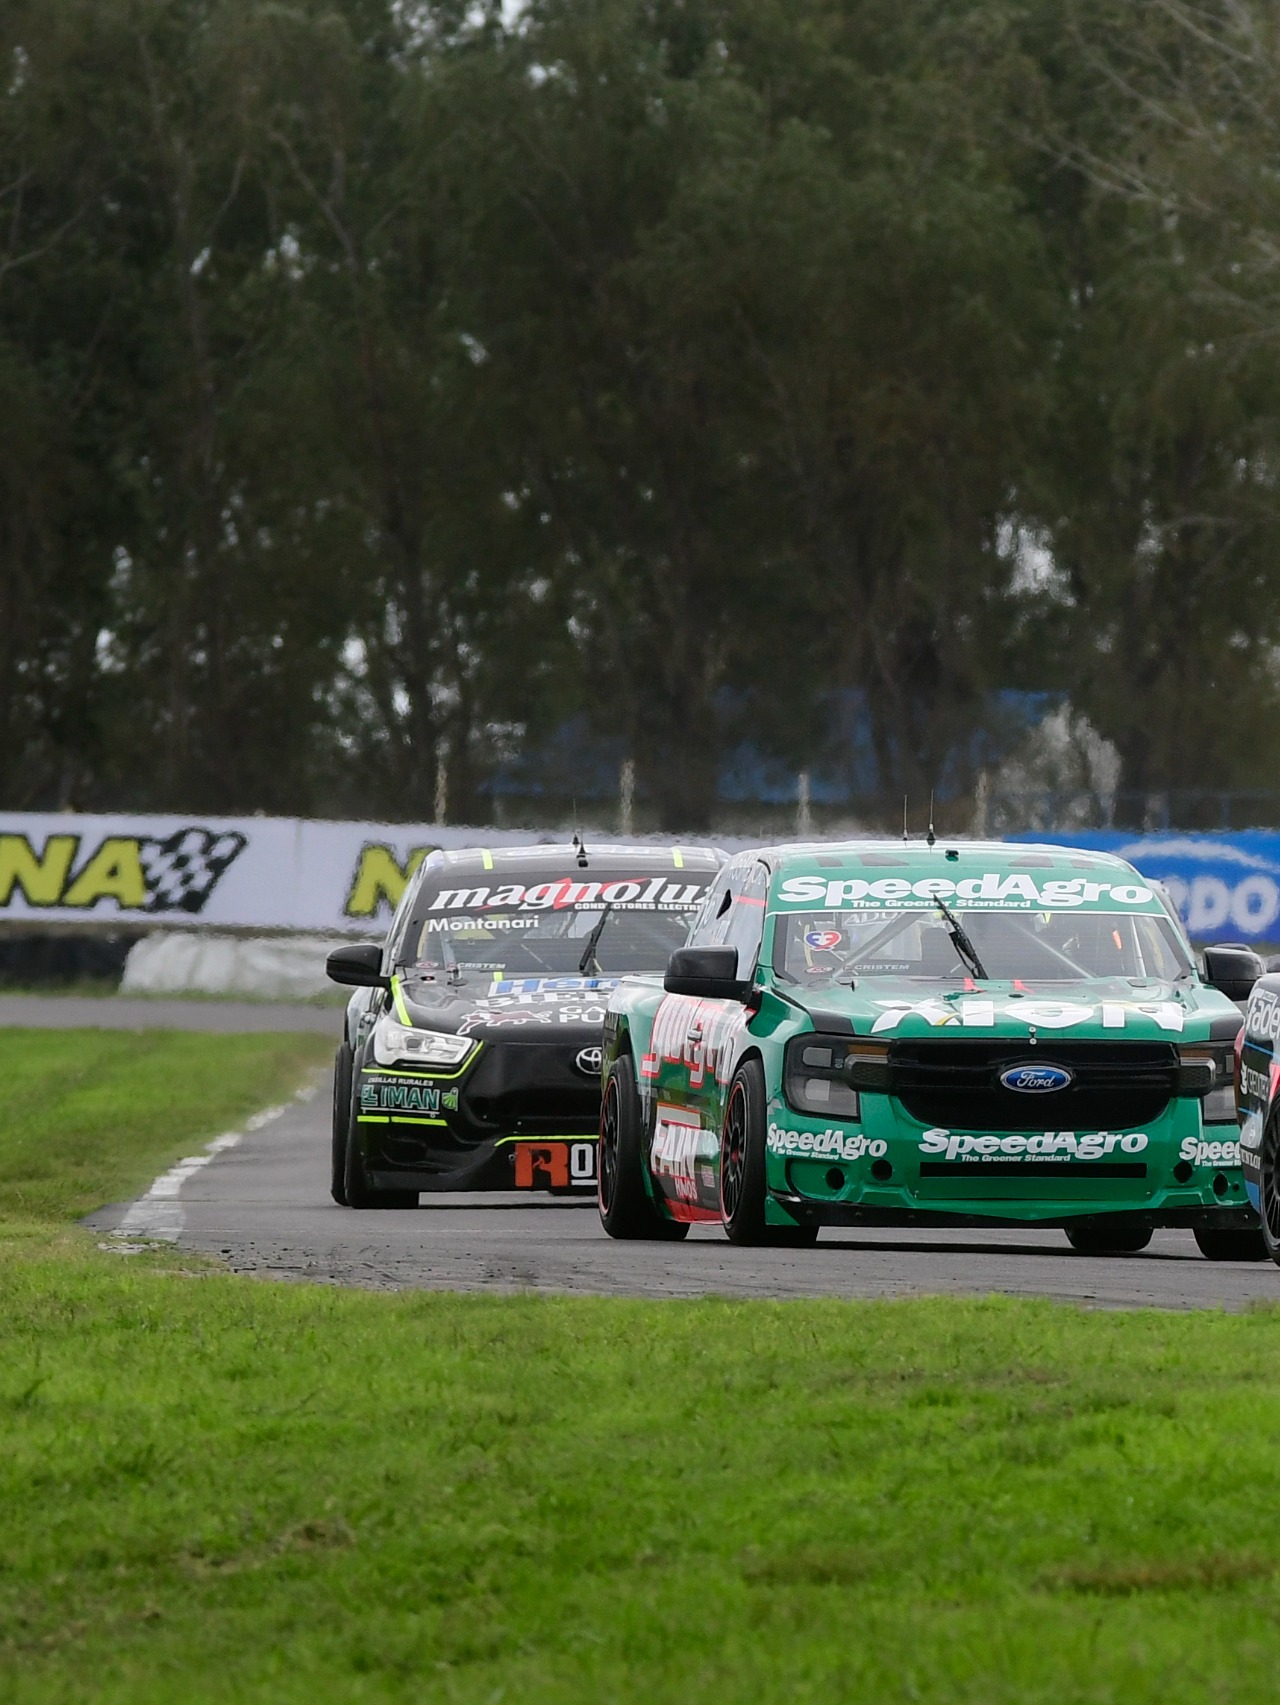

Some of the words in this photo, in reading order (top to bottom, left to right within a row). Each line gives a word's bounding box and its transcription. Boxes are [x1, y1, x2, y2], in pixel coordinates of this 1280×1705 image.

[777, 873, 1154, 907] SpeedAgro
[574, 902, 656, 910] CONDCTORES
[956, 899, 1031, 908] Standard
[428, 915, 539, 932] Montanari
[1015, 1071, 1056, 1089] Ford
[380, 1085, 440, 1111] IMAN
[766, 1122, 888, 1160] SpeedAgro
[918, 1128, 1148, 1161] SpeedAgro
[514, 1142, 600, 1187] RO
[961, 1154, 980, 1162] The
[981, 1154, 1023, 1162] Greener
[1024, 1154, 1071, 1162] Standard
